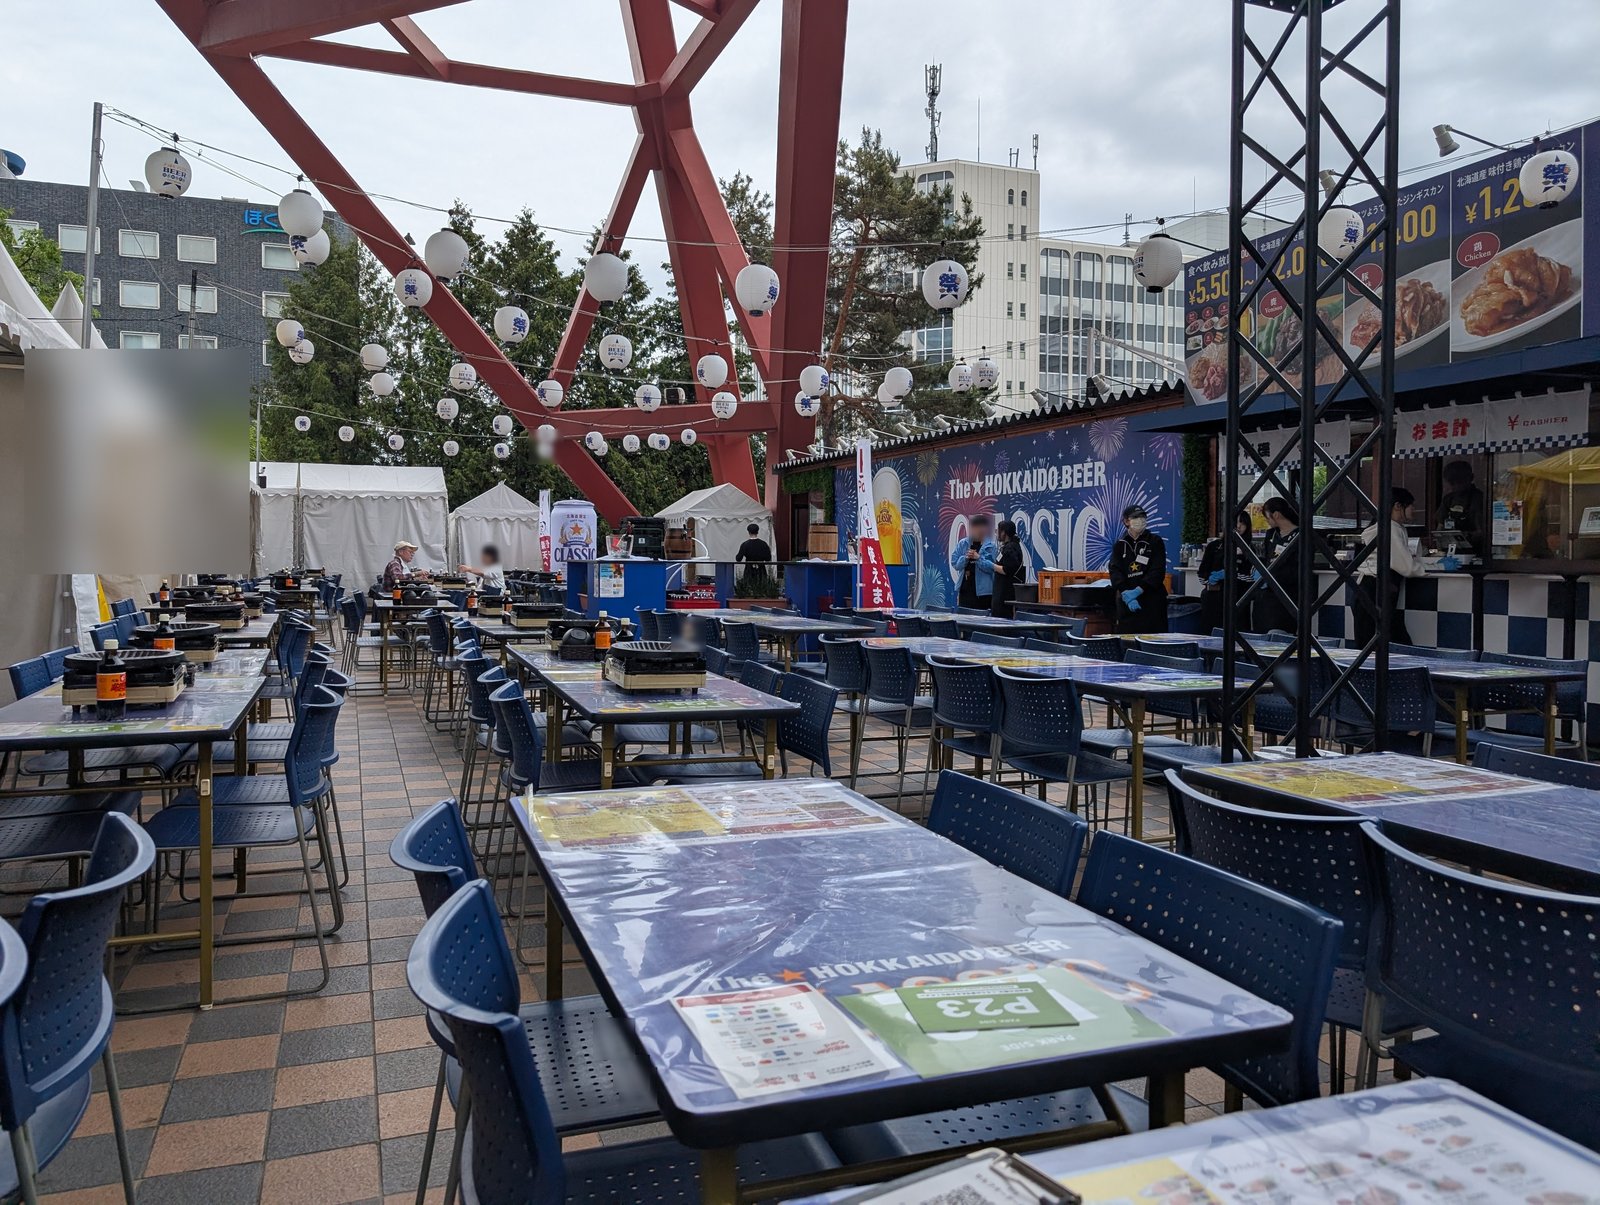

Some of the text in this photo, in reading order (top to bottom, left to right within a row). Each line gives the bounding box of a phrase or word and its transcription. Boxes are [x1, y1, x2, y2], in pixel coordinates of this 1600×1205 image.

[163, 166, 187, 178] BEER
[1542, 163, 1571, 185] 祭
[1465, 177, 1537, 224] ¥1,2
[244, 210, 279, 228] ほく
[1187, 253, 1230, 278] 食べ飲み放
[1465, 249, 1492, 262] Chicken
[939, 273, 961, 293] 祭
[1411, 418, 1471, 442] お会計
[1522, 416, 1569, 427] CASHIER
[949, 461, 1107, 500] The HOKKAIDO BEER
[554, 547, 596, 562] CLASSIC
[949, 505, 1108, 585] CSSIC
[867, 546, 884, 608] 使えま
[702, 939, 1071, 992] The HOKKAIDO BEER
[940, 996, 1042, 1018] P23
